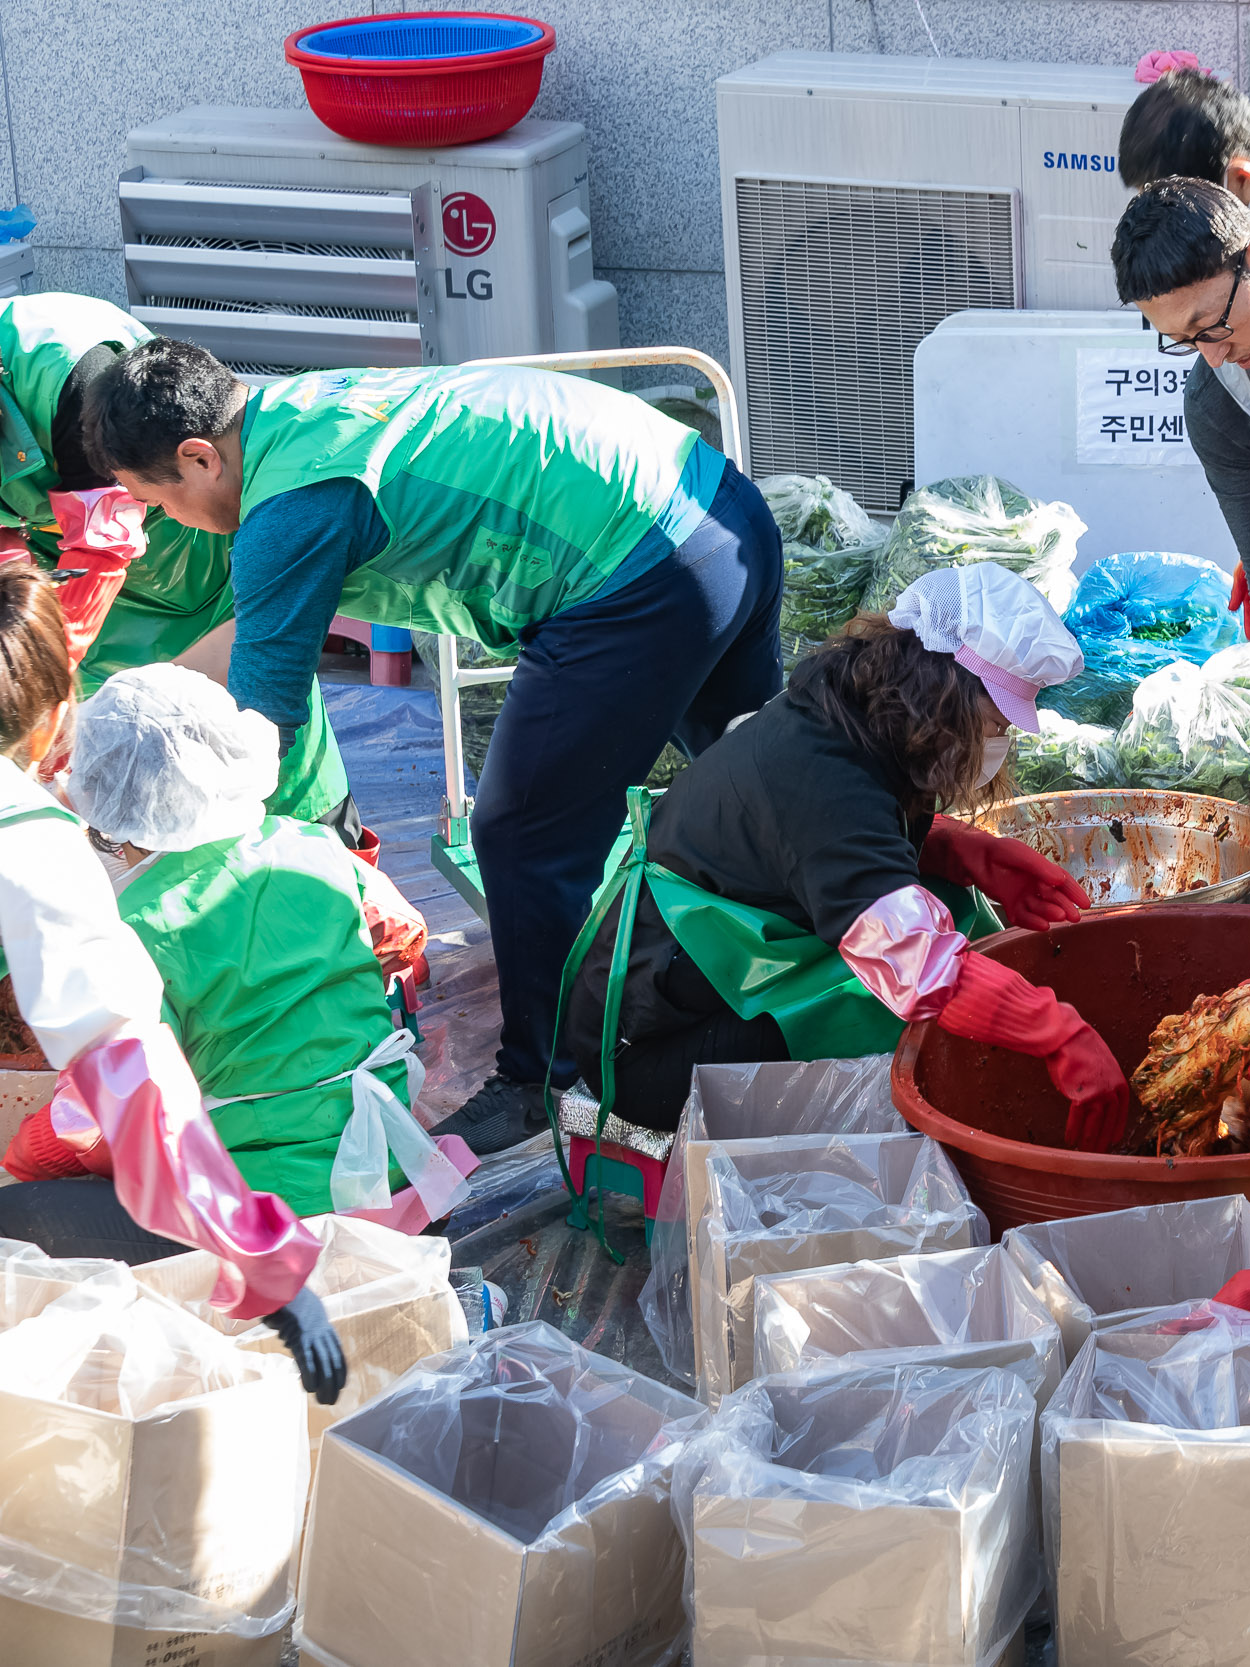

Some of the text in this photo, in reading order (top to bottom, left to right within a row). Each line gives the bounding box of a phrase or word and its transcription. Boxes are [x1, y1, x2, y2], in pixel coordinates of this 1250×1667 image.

[1043, 151, 1119, 172] SAMSU
[444, 267, 494, 301] LG
[1100, 415, 1187, 443] 주민센
